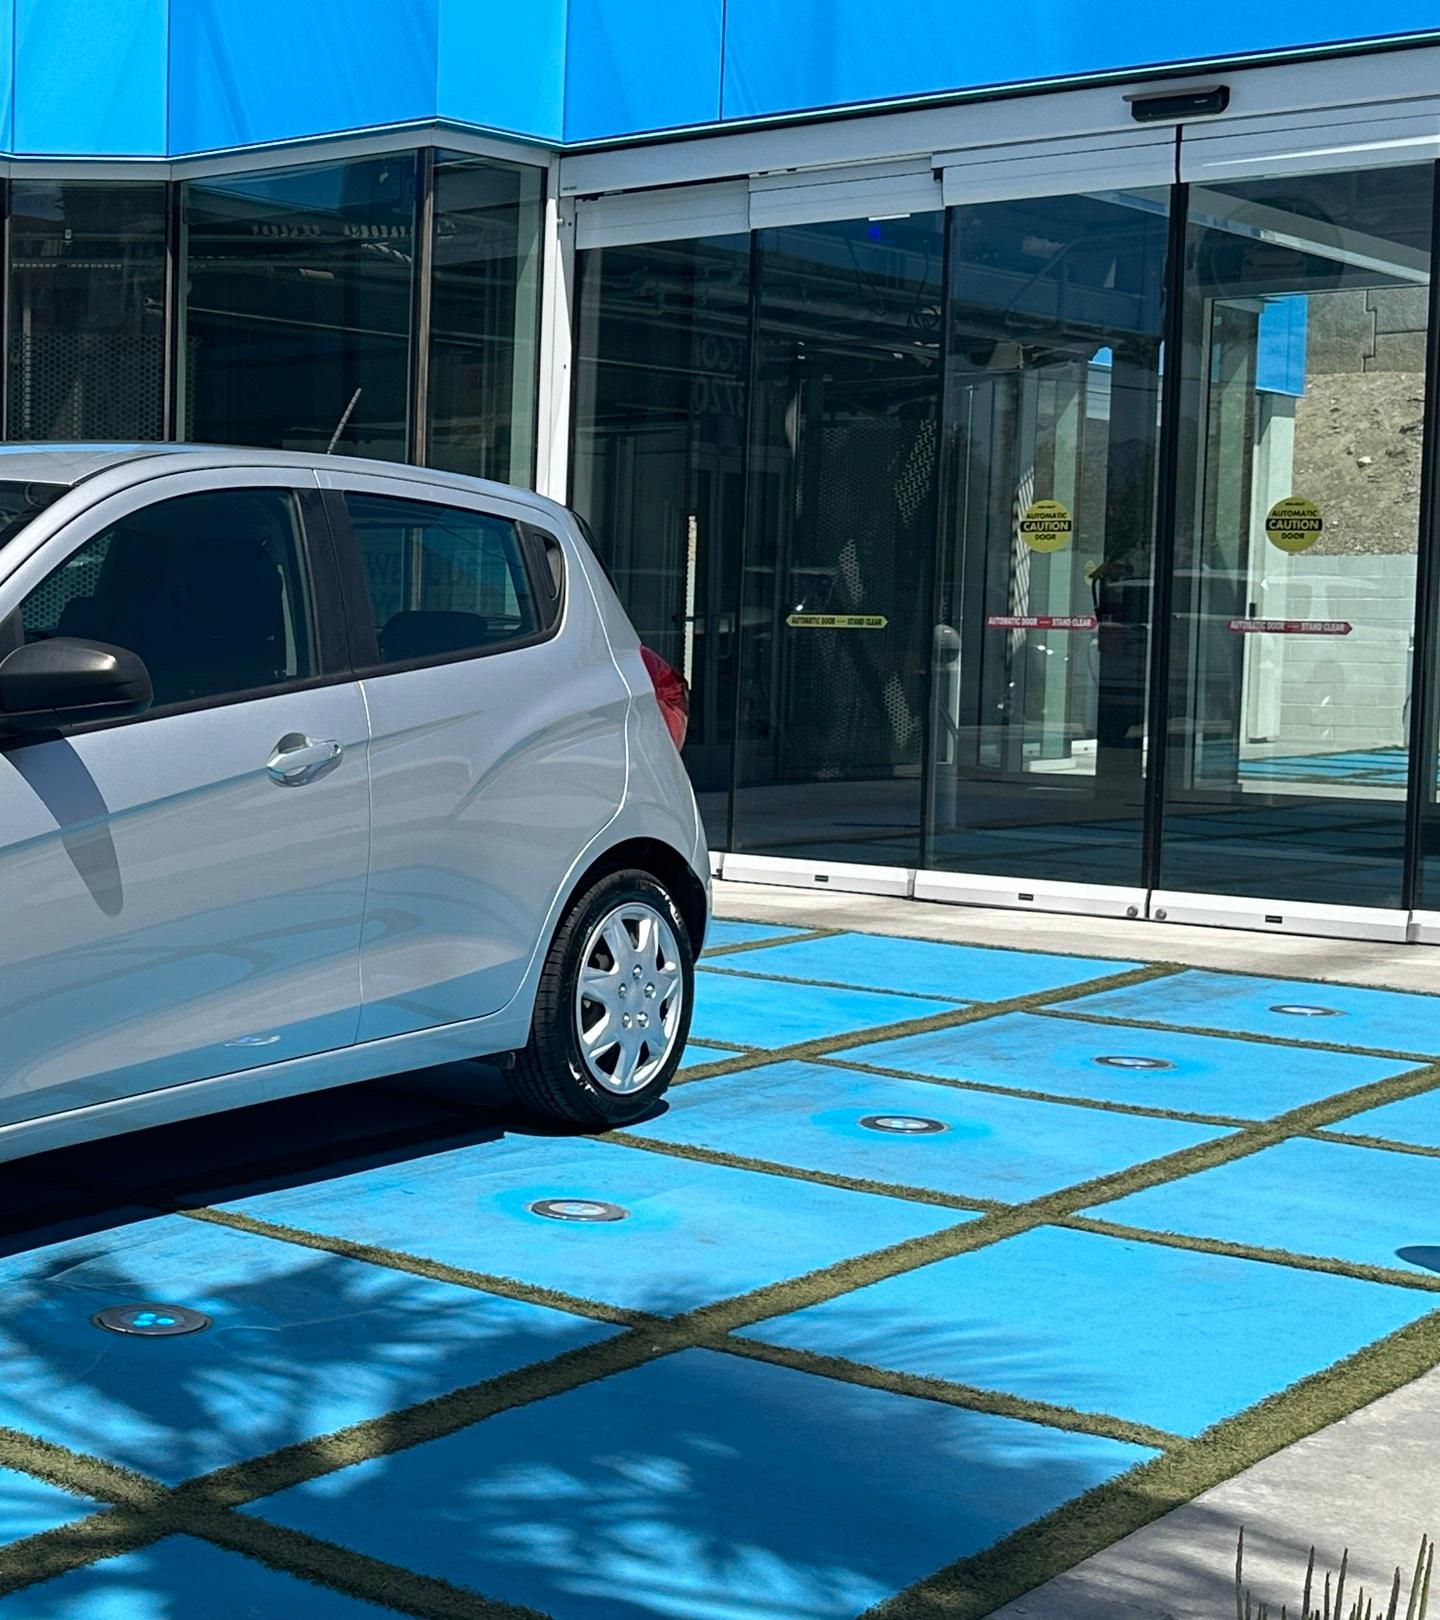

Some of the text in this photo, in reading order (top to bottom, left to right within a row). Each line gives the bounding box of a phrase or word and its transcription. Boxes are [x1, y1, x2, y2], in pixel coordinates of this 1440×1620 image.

[1272, 509, 1318, 517] AUTOMATIC
[1023, 521, 1069, 531] CAUTION
[1269, 519, 1319, 530] CAUTION
[1281, 532, 1305, 540] DOOR
[821, 617, 835, 625] DOOR
[1021, 617, 1038, 626] DOOR
[1072, 618, 1091, 627] CLEAR
[1323, 623, 1345, 632] CLEAR
